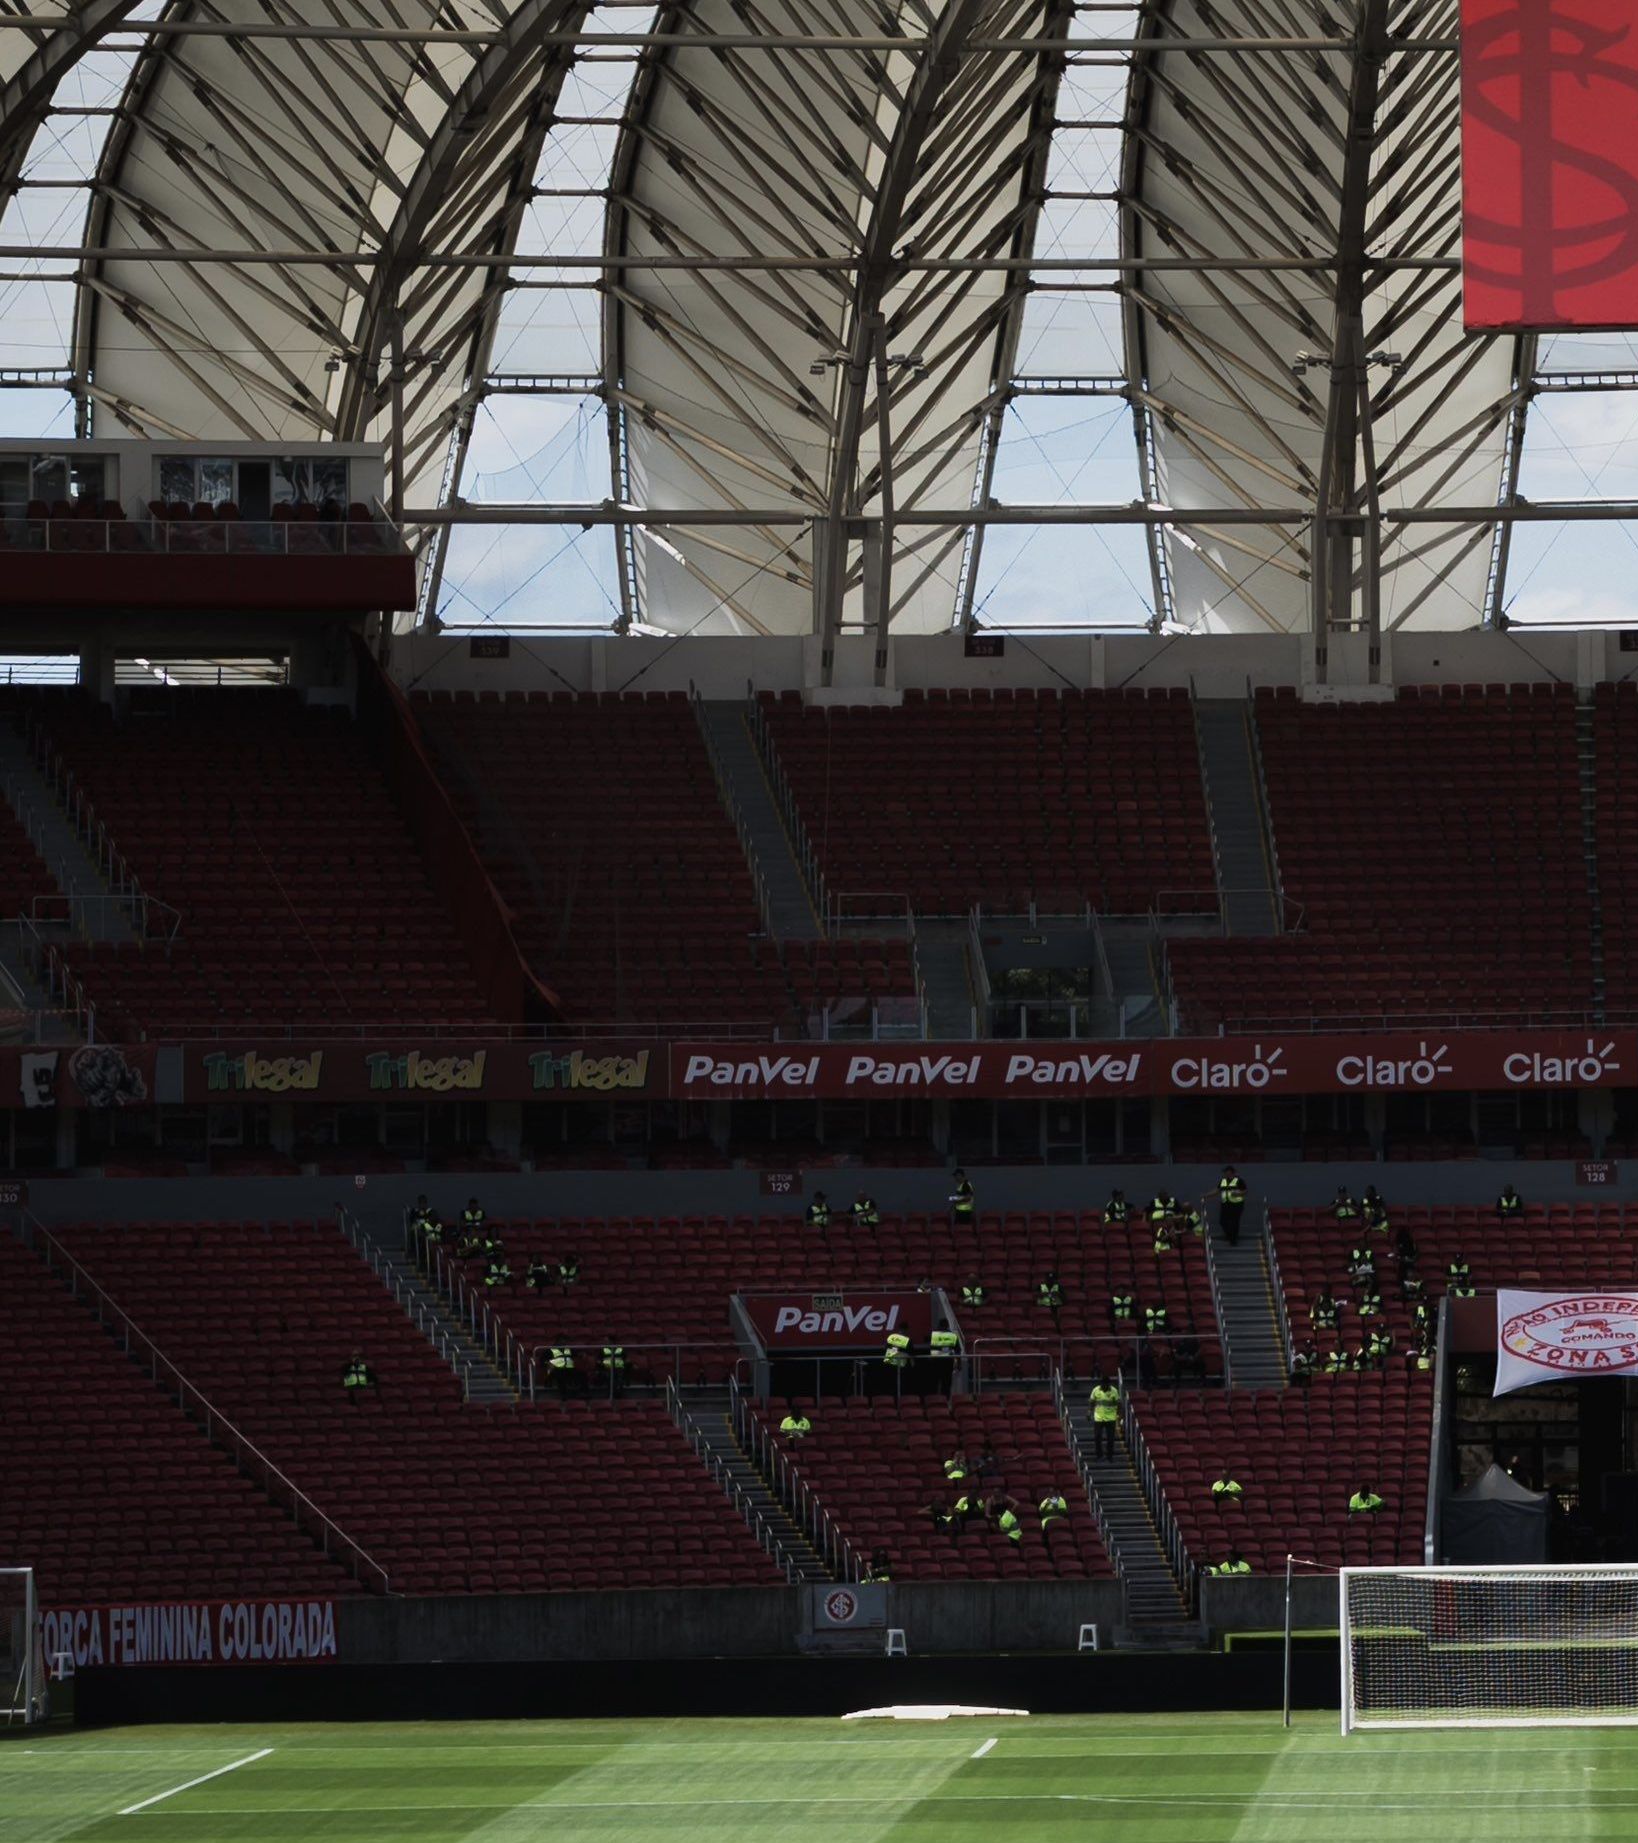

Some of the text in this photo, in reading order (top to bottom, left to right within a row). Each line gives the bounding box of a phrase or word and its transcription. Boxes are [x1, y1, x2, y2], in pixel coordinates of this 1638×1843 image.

[203, 1051, 324, 1092] Trilegal
[366, 1050, 487, 1091] Trilegal
[528, 1050, 650, 1090] Trilegal
[684, 1055, 821, 1085] PanVel
[845, 1055, 982, 1085] PanVel
[1005, 1053, 1142, 1084] PanVel
[1171, 1057, 1270, 1088] Claro
[1336, 1055, 1435, 1085] Claro
[1503, 1052, 1601, 1082] Claro
[771, 1182, 791, 1192] 129
[1586, 1172, 1605, 1182] 128
[774, 1304, 900, 1334] PanVel
[1561, 1332, 1636, 1343] COMANDO
[1528, 1342, 1611, 1366] ZONA
[109, 1605, 213, 1664] FEMININA
[219, 1601, 337, 1661] COLORADA
